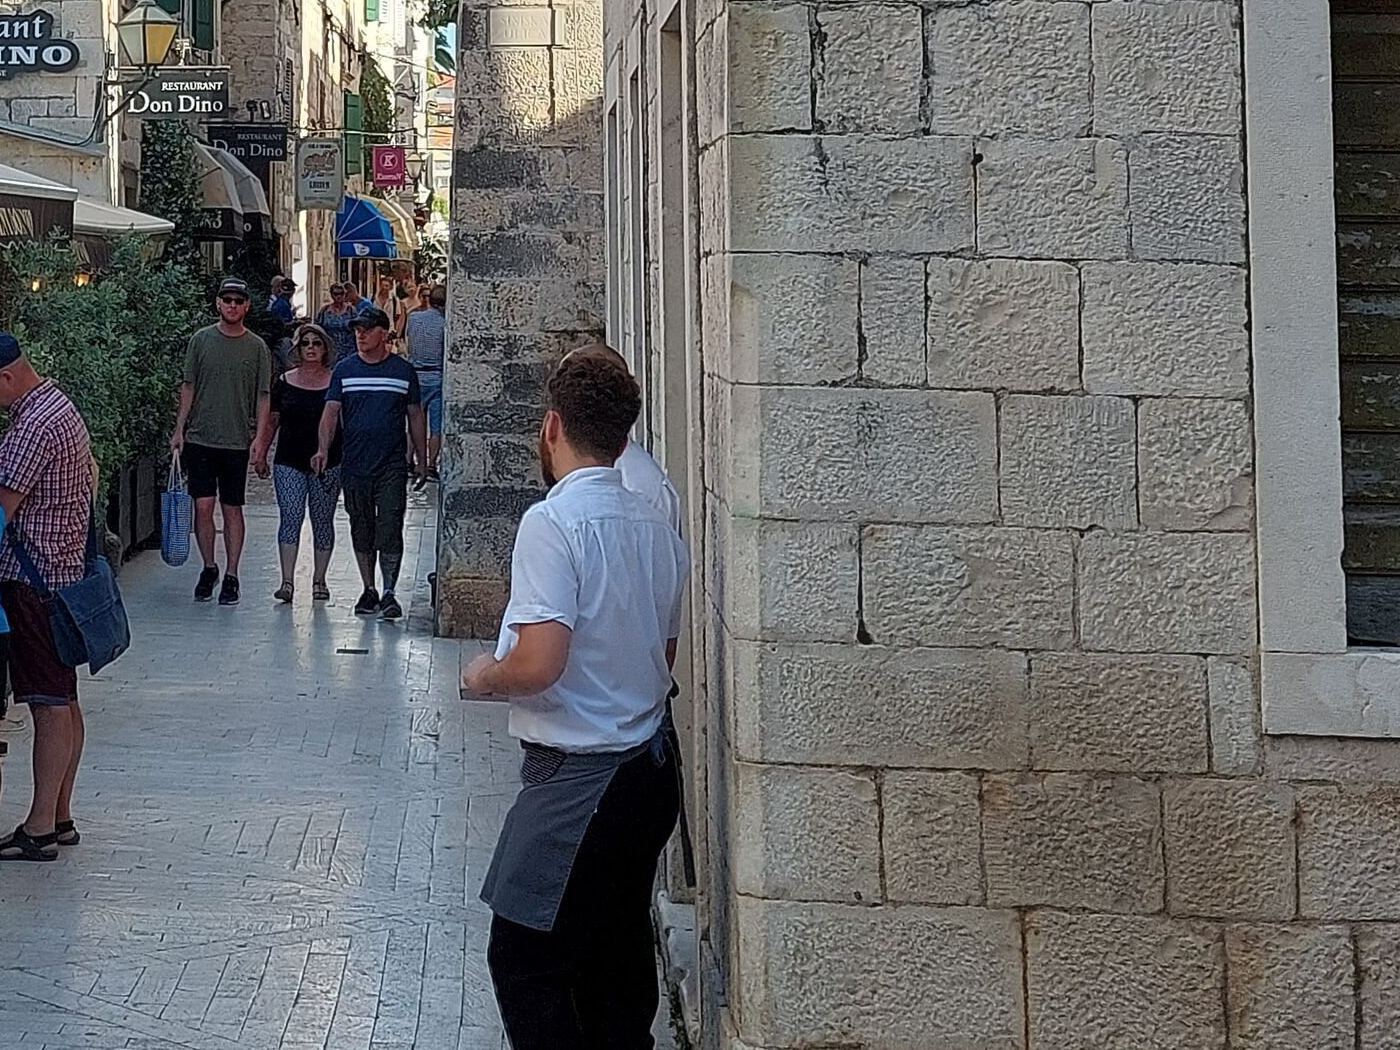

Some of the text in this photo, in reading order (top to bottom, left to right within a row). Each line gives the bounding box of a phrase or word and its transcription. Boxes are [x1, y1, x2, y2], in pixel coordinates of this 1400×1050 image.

[161, 81, 224, 91] RESTAURANT
[127, 91, 224, 113] Don Dino
[237, 133, 283, 141] RESTAURANT
[212, 139, 283, 157] Don Dino
